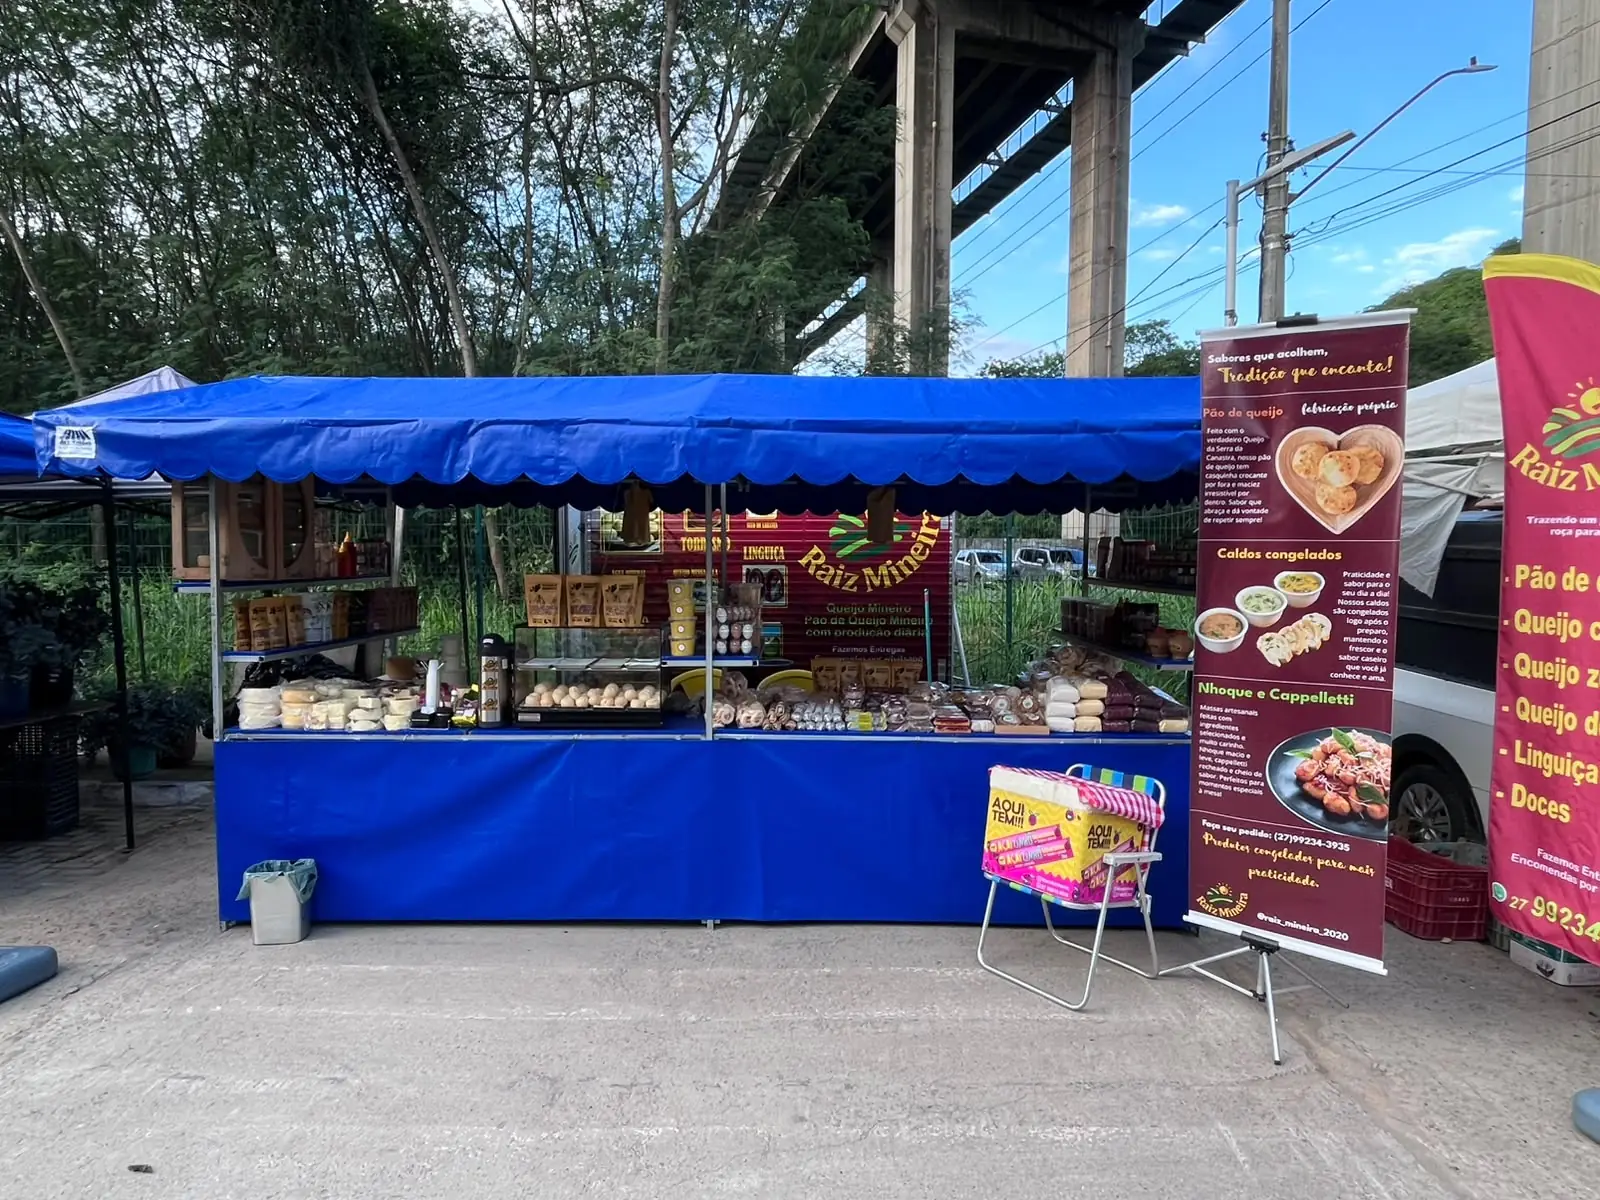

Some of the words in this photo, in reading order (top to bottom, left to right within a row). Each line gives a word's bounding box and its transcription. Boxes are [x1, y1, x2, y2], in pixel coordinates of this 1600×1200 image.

[1208, 353, 1251, 364] Sabores
[1254, 352, 1274, 363] que
[1277, 347, 1328, 359] acolhem,
[1218, 366, 1286, 384] Tradição
[1292, 367, 1318, 384] que
[1322, 356, 1394, 376] encanta!
[1203, 407, 1225, 417] Pão
[1228, 408, 1242, 417] de
[1245, 406, 1284, 420] queijo
[1302, 403, 1354, 415] fabricação
[1357, 400, 1399, 415] própria
[1243, 436, 1265, 444] Queijo
[1258, 454, 1271, 462] pão
[1509, 443, 1579, 491] Raiz
[1526, 516, 1578, 524] Trazendo
[1550, 529, 1573, 537] roça
[1575, 529, 1600, 539] para
[743, 546, 785, 562] LINGUIÇA
[1217, 548, 1262, 560] Caldos
[1265, 548, 1342, 563] congelados
[798, 545, 860, 593] Raiz
[1343, 571, 1385, 579] Praticidade
[1515, 564, 1556, 590] Pão
[1562, 566, 1590, 592] de
[1376, 590, 1390, 598] dia!
[826, 603, 865, 615] Queijo
[868, 603, 912, 613] Mineiro
[1348, 608, 1389, 617] congelados
[830, 616, 845, 625] de
[849, 615, 886, 627] Queijo
[1347, 618, 1362, 626] logo
[1364, 618, 1382, 626] após
[1514, 608, 1583, 643] Queijo
[806, 629, 831, 637] com
[1357, 628, 1388, 636] preparo,
[870, 646, 906, 654] Entregas
[1349, 645, 1374, 653] frescor
[1339, 654, 1360, 662] sabor
[1361, 656, 1387, 664] caseiro
[1380, 665, 1387, 673] já
[1514, 653, 1580, 689] Queijo
[1330, 672, 1360, 680] conhece
[1198, 682, 1253, 699] Nhoque
[1257, 690, 1266, 699] e
[1270, 689, 1354, 706] Cappelletti
[1200, 705, 1223, 713] Massas
[1224, 708, 1258, 716] artesanais
[1516, 697, 1578, 735] Queijo
[1200, 722, 1239, 732] ingredientes
[1200, 730, 1240, 740] selecionados
[1199, 747, 1224, 755] Nhoque
[1226, 750, 1245, 758] macio
[1199, 764, 1228, 773] recheado
[1215, 758, 1247, 767] cappelletti
[1515, 740, 1599, 786] Linguiça
[1220, 775, 1248, 785] Perfeitos
[1199, 781, 1232, 791] momentos
[1233, 786, 1263, 796] especiais
[992, 797, 1025, 817] AQUI
[1511, 783, 1571, 823] Doces
[992, 810, 1025, 829] TEM!!!
[1088, 825, 1112, 838] AQUI
[1202, 819, 1220, 831] Faça
[1222, 824, 1237, 834] seu
[1239, 827, 1273, 840] pedido:
[1274, 832, 1351, 852] (27)99234-3935
[1088, 838, 1111, 849] TEM!!!
[1203, 832, 1250, 854] Produtos
[1254, 845, 1313, 864] congelados
[1316, 857, 1347, 870] para
[1349, 864, 1376, 877] mais
[1537, 848, 1580, 872] Fazemos
[1248, 868, 1320, 888] praticidade.
[1511, 853, 1578, 885] Encomendas
[1580, 880, 1598, 893] por
[1196, 895, 1220, 916] Raiz
[1219, 893, 1249, 918] Mineira
[1509, 896, 1529, 911] 27
[1530, 896, 1600, 942] 99234
[1257, 912, 1349, 942] @raiz_mineira_2020
